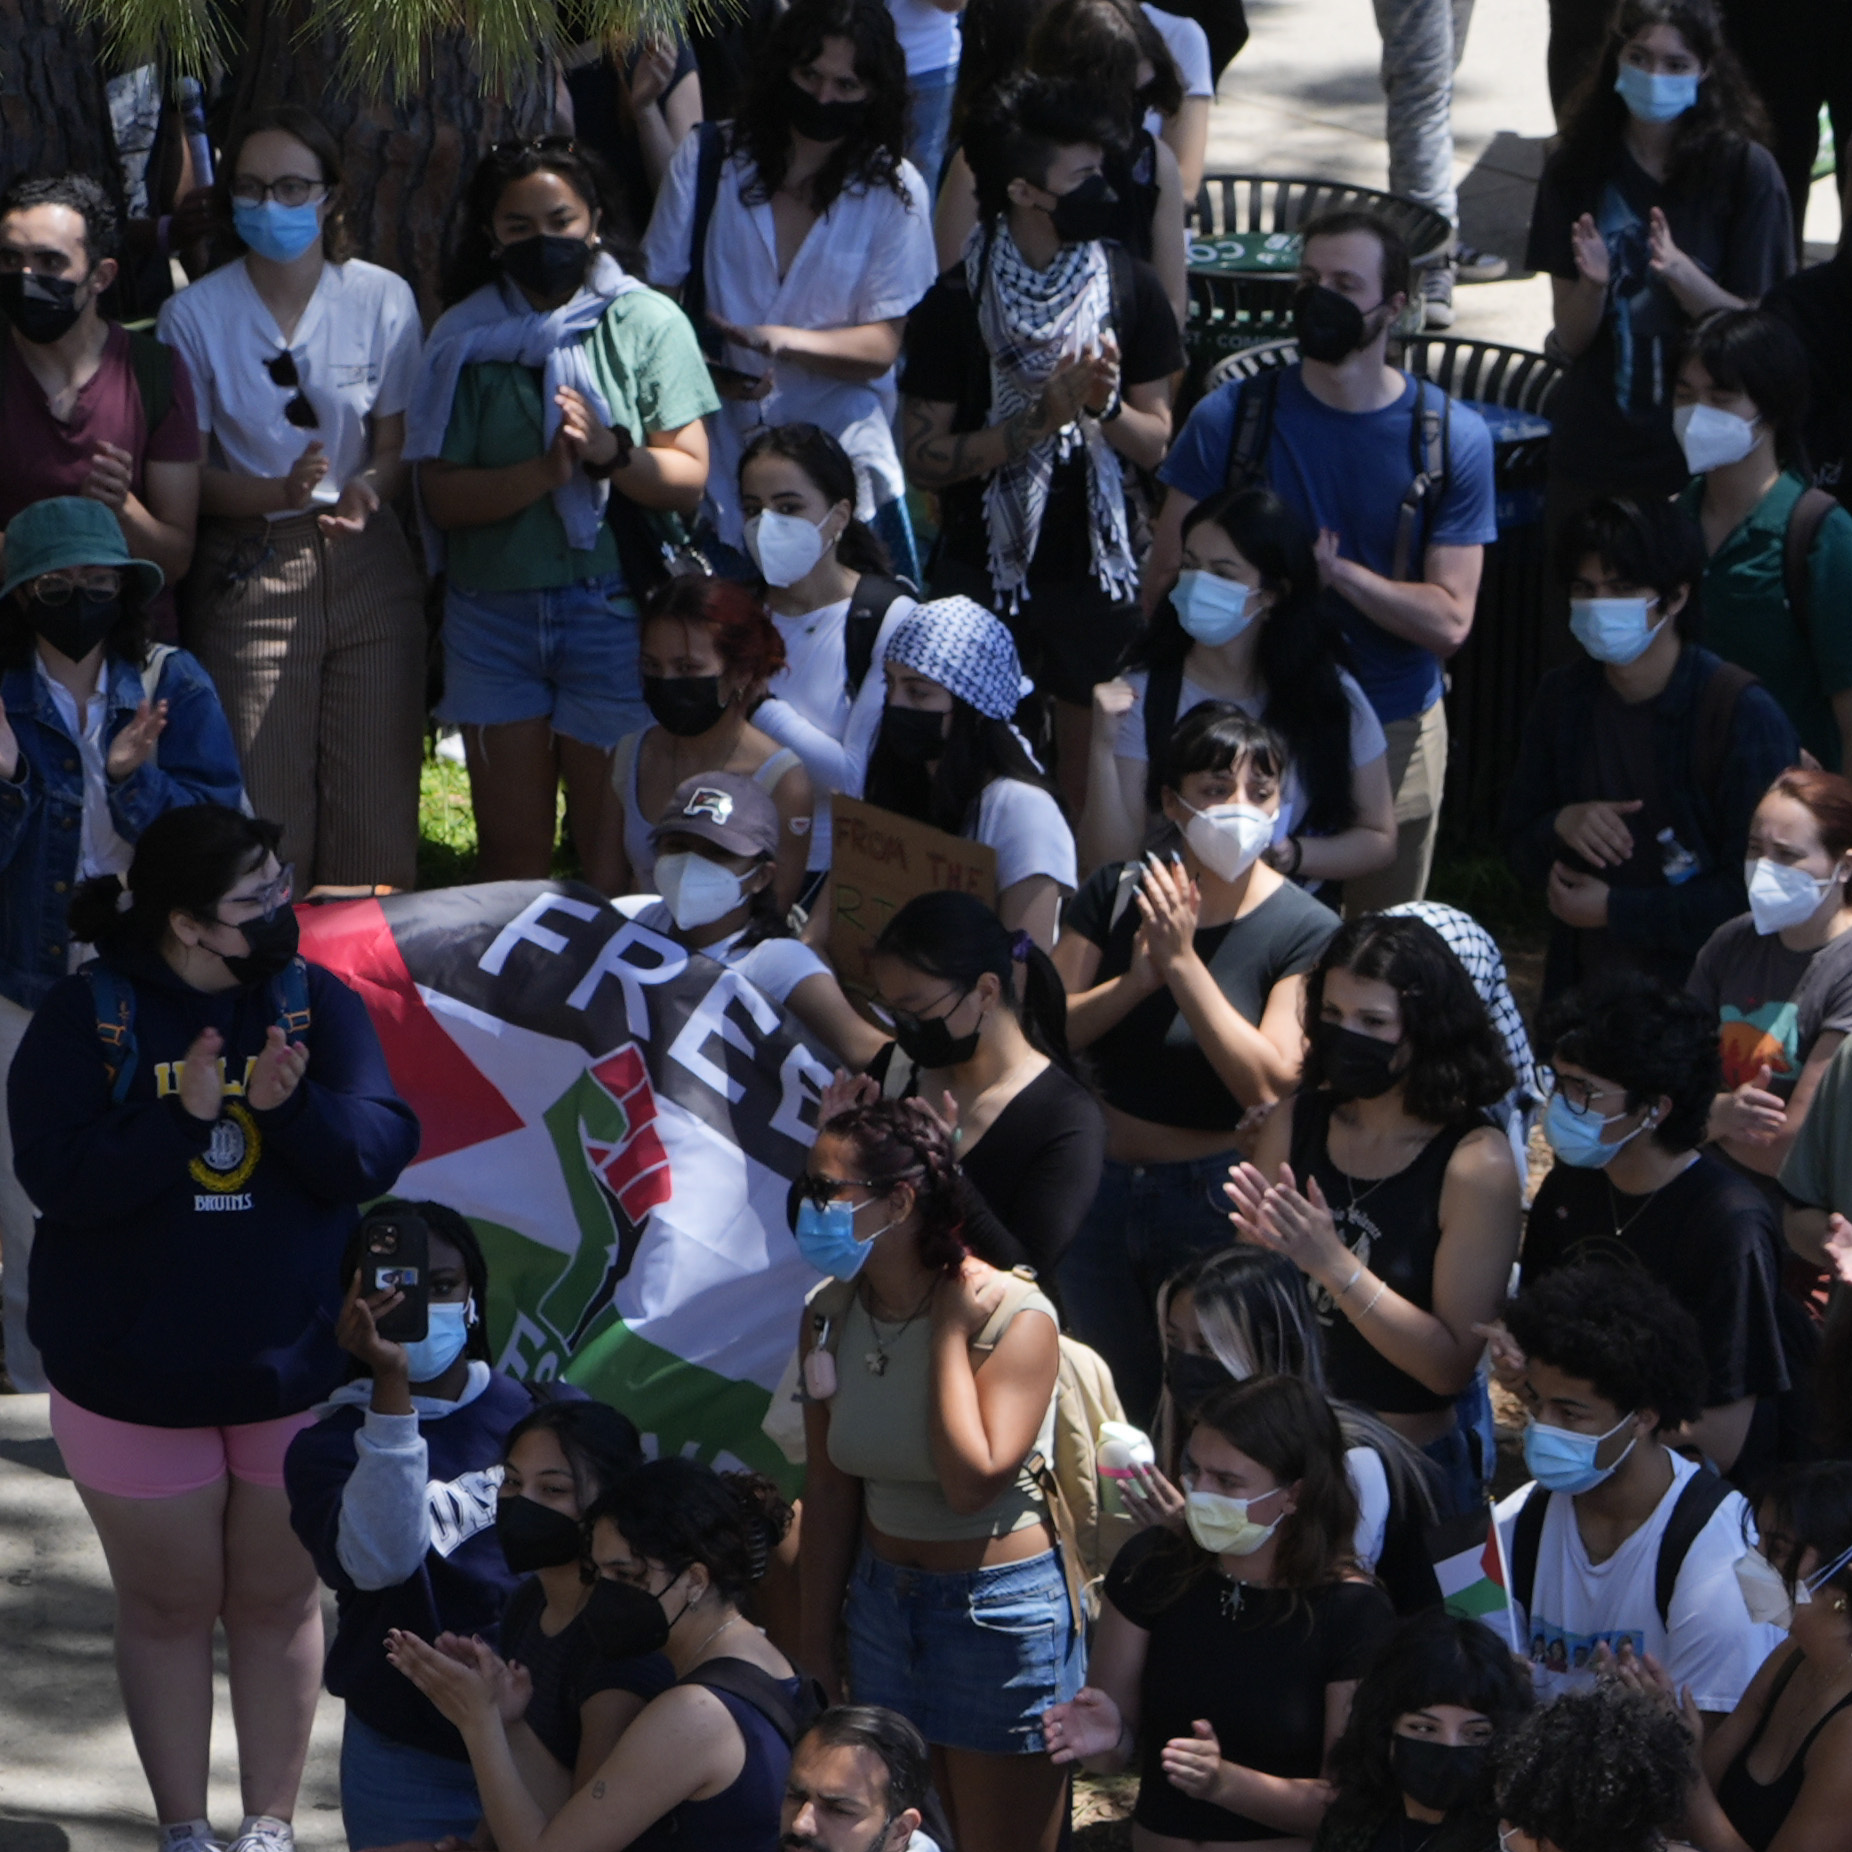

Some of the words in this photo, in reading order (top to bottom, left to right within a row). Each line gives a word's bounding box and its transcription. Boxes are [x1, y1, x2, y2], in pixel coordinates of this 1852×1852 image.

[834, 816, 909, 873] FROM
[927, 851, 984, 892] THE
[478, 892, 834, 1148] FREE
[194, 1193, 254, 1212] BRUINS
